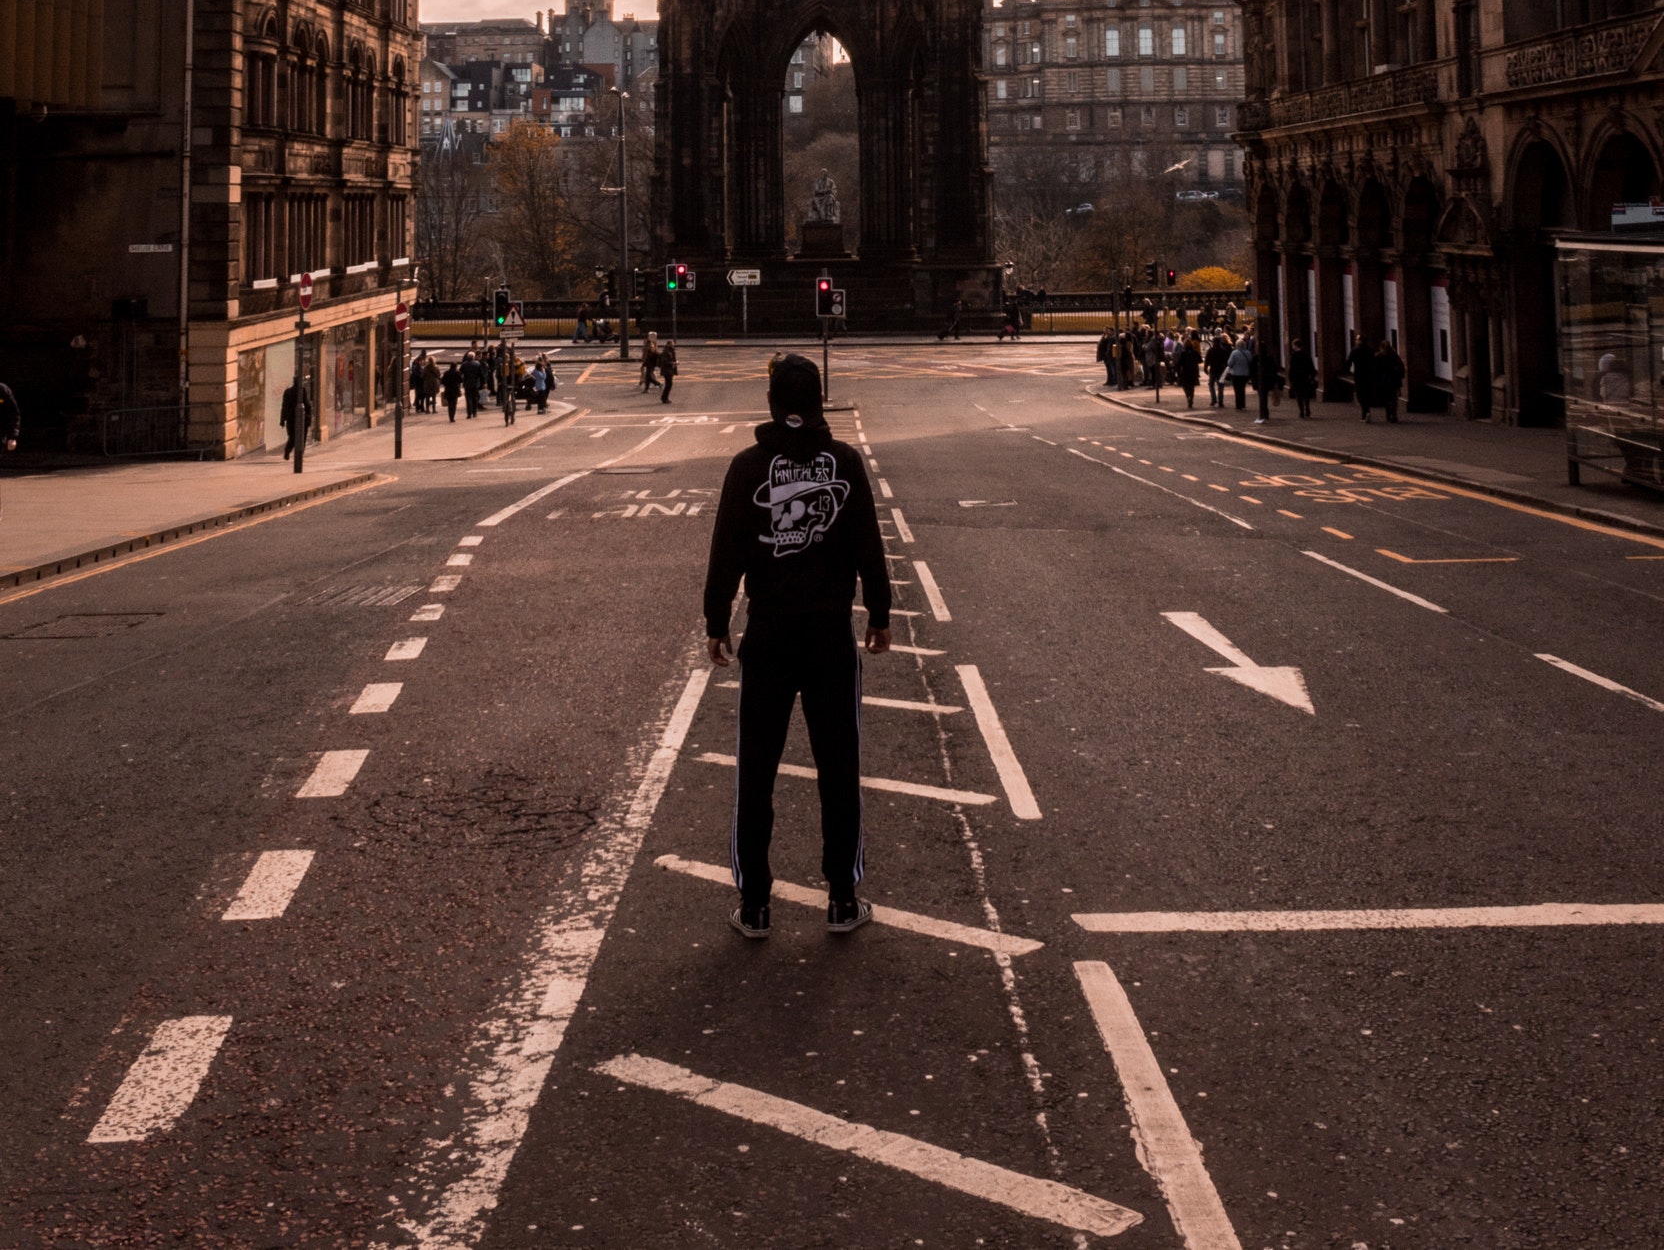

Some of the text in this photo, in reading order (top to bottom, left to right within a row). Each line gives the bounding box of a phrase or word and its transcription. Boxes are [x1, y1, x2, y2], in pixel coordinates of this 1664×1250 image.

[775, 467, 830, 484] KNUCKLES
[1294, 486, 1452, 503] BUS
[818, 494, 830, 513] 13
